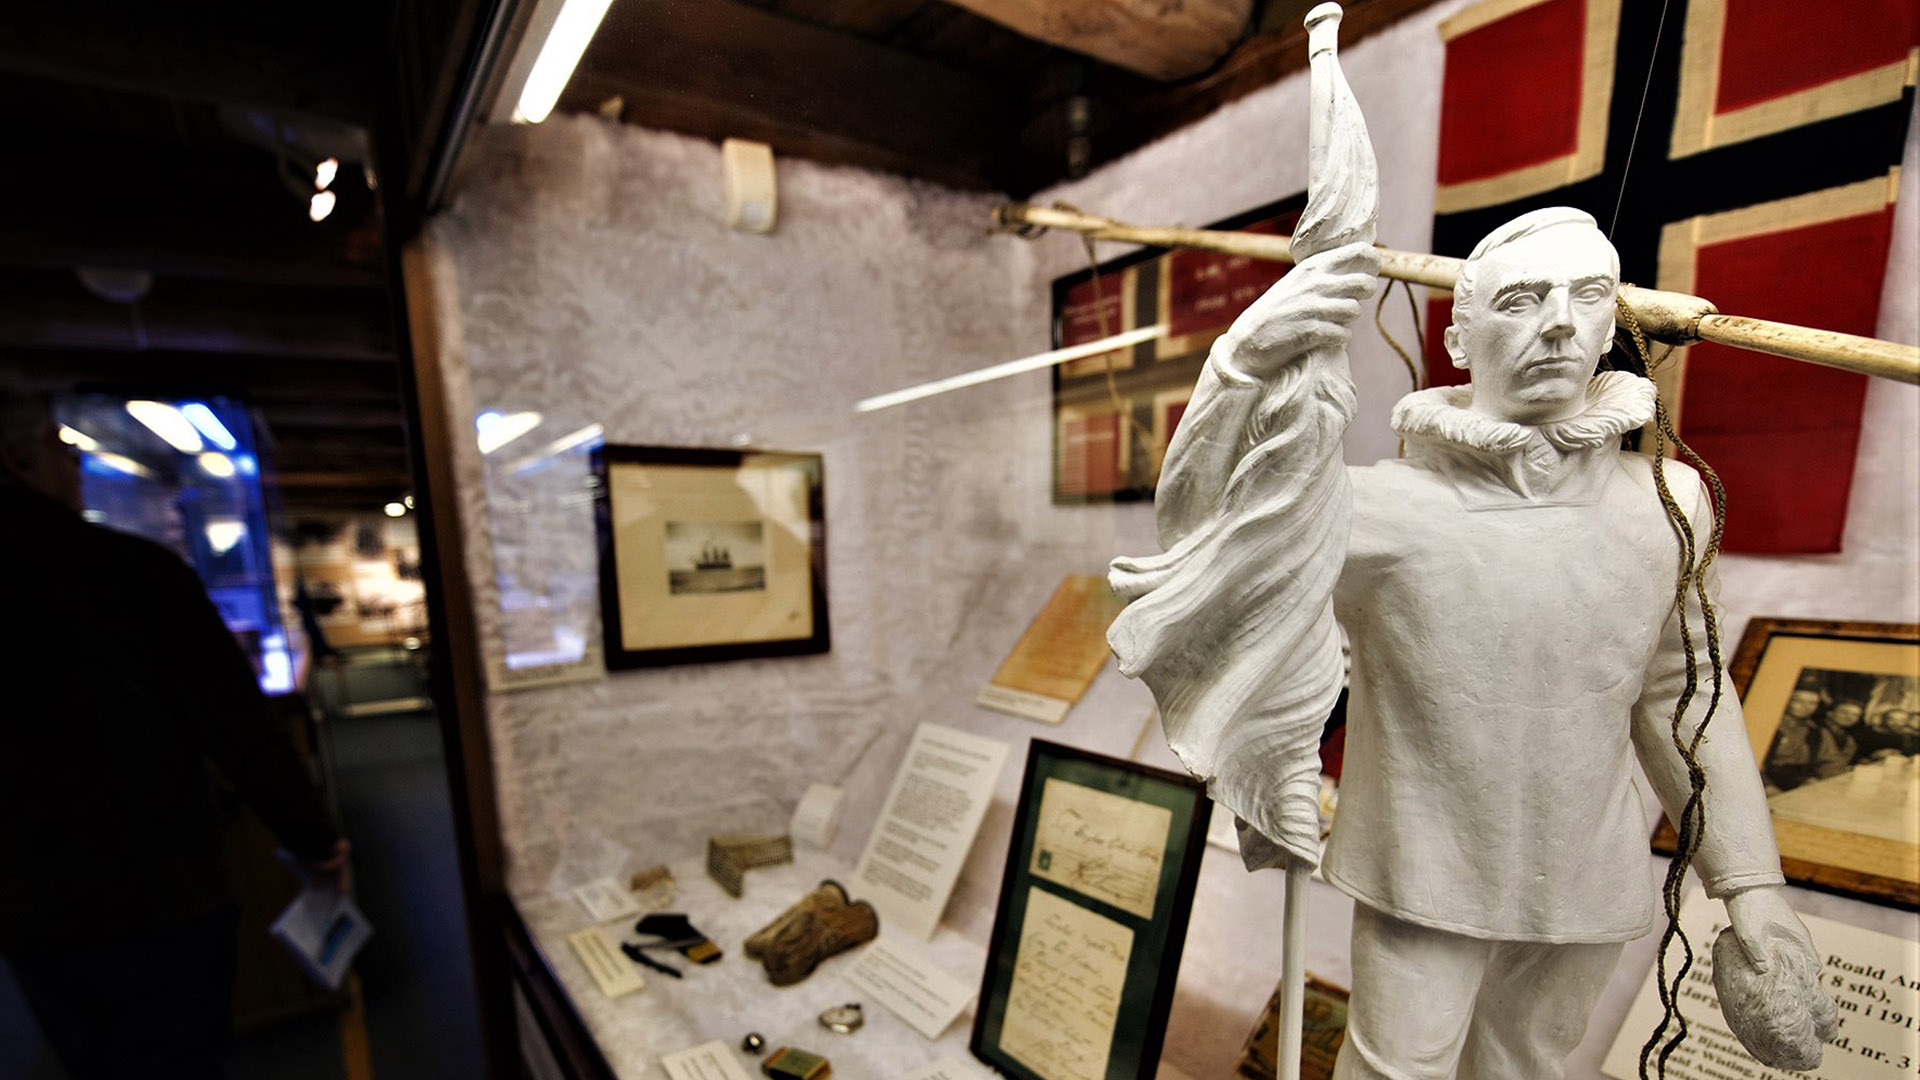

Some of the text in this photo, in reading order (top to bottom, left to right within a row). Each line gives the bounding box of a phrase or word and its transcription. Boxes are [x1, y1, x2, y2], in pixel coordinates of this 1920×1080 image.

[1826, 954, 1886, 981] Roald
[1880, 1008, 1920, 1033] 191
[1860, 1045, 1890, 1064] nr.
[1896, 1055, 1911, 1070] 3
